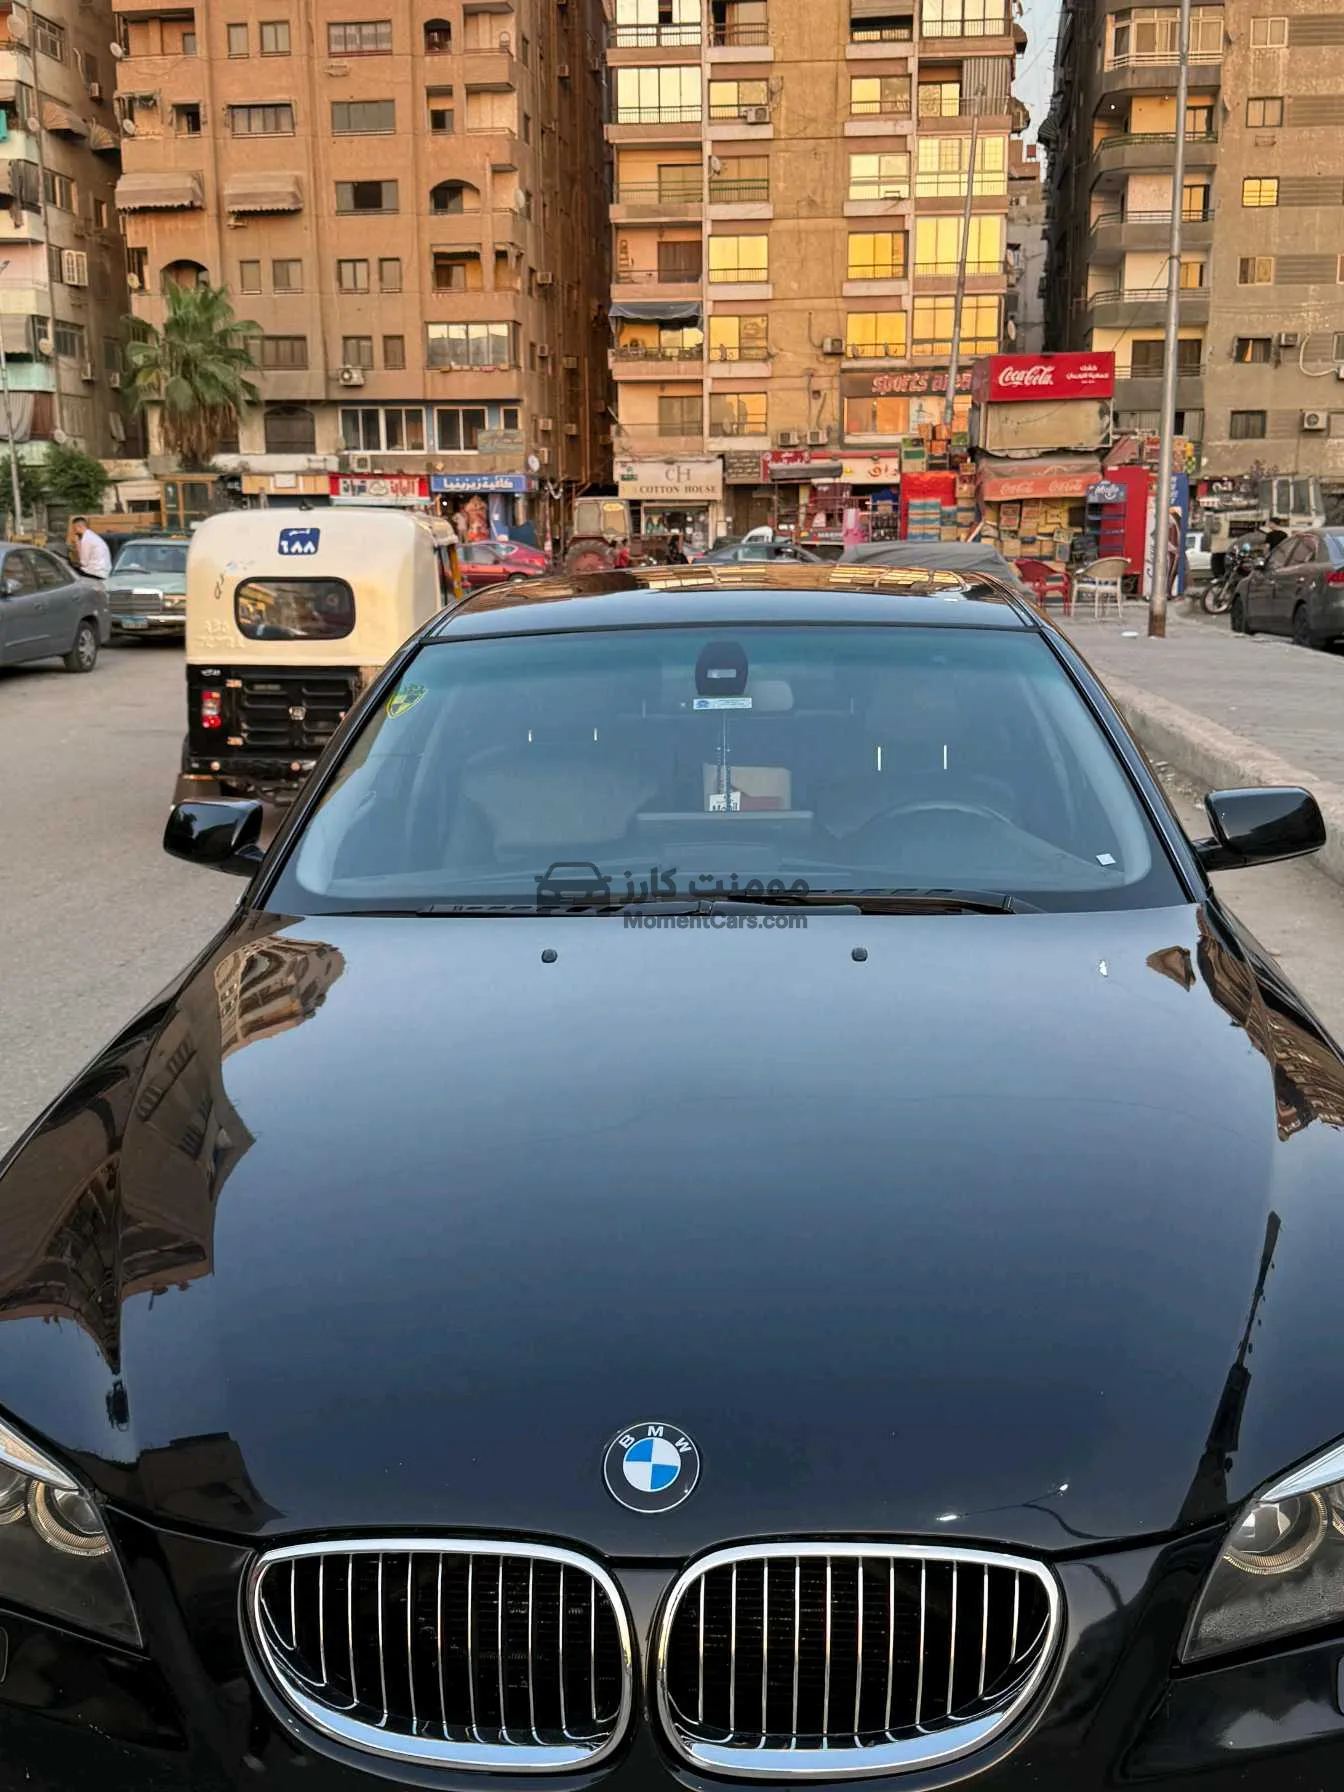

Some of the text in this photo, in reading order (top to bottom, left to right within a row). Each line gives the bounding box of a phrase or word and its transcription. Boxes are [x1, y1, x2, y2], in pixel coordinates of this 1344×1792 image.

[639, 485, 717, 494] COTTON HOUSE
[618, 1425, 692, 1453] BMW
